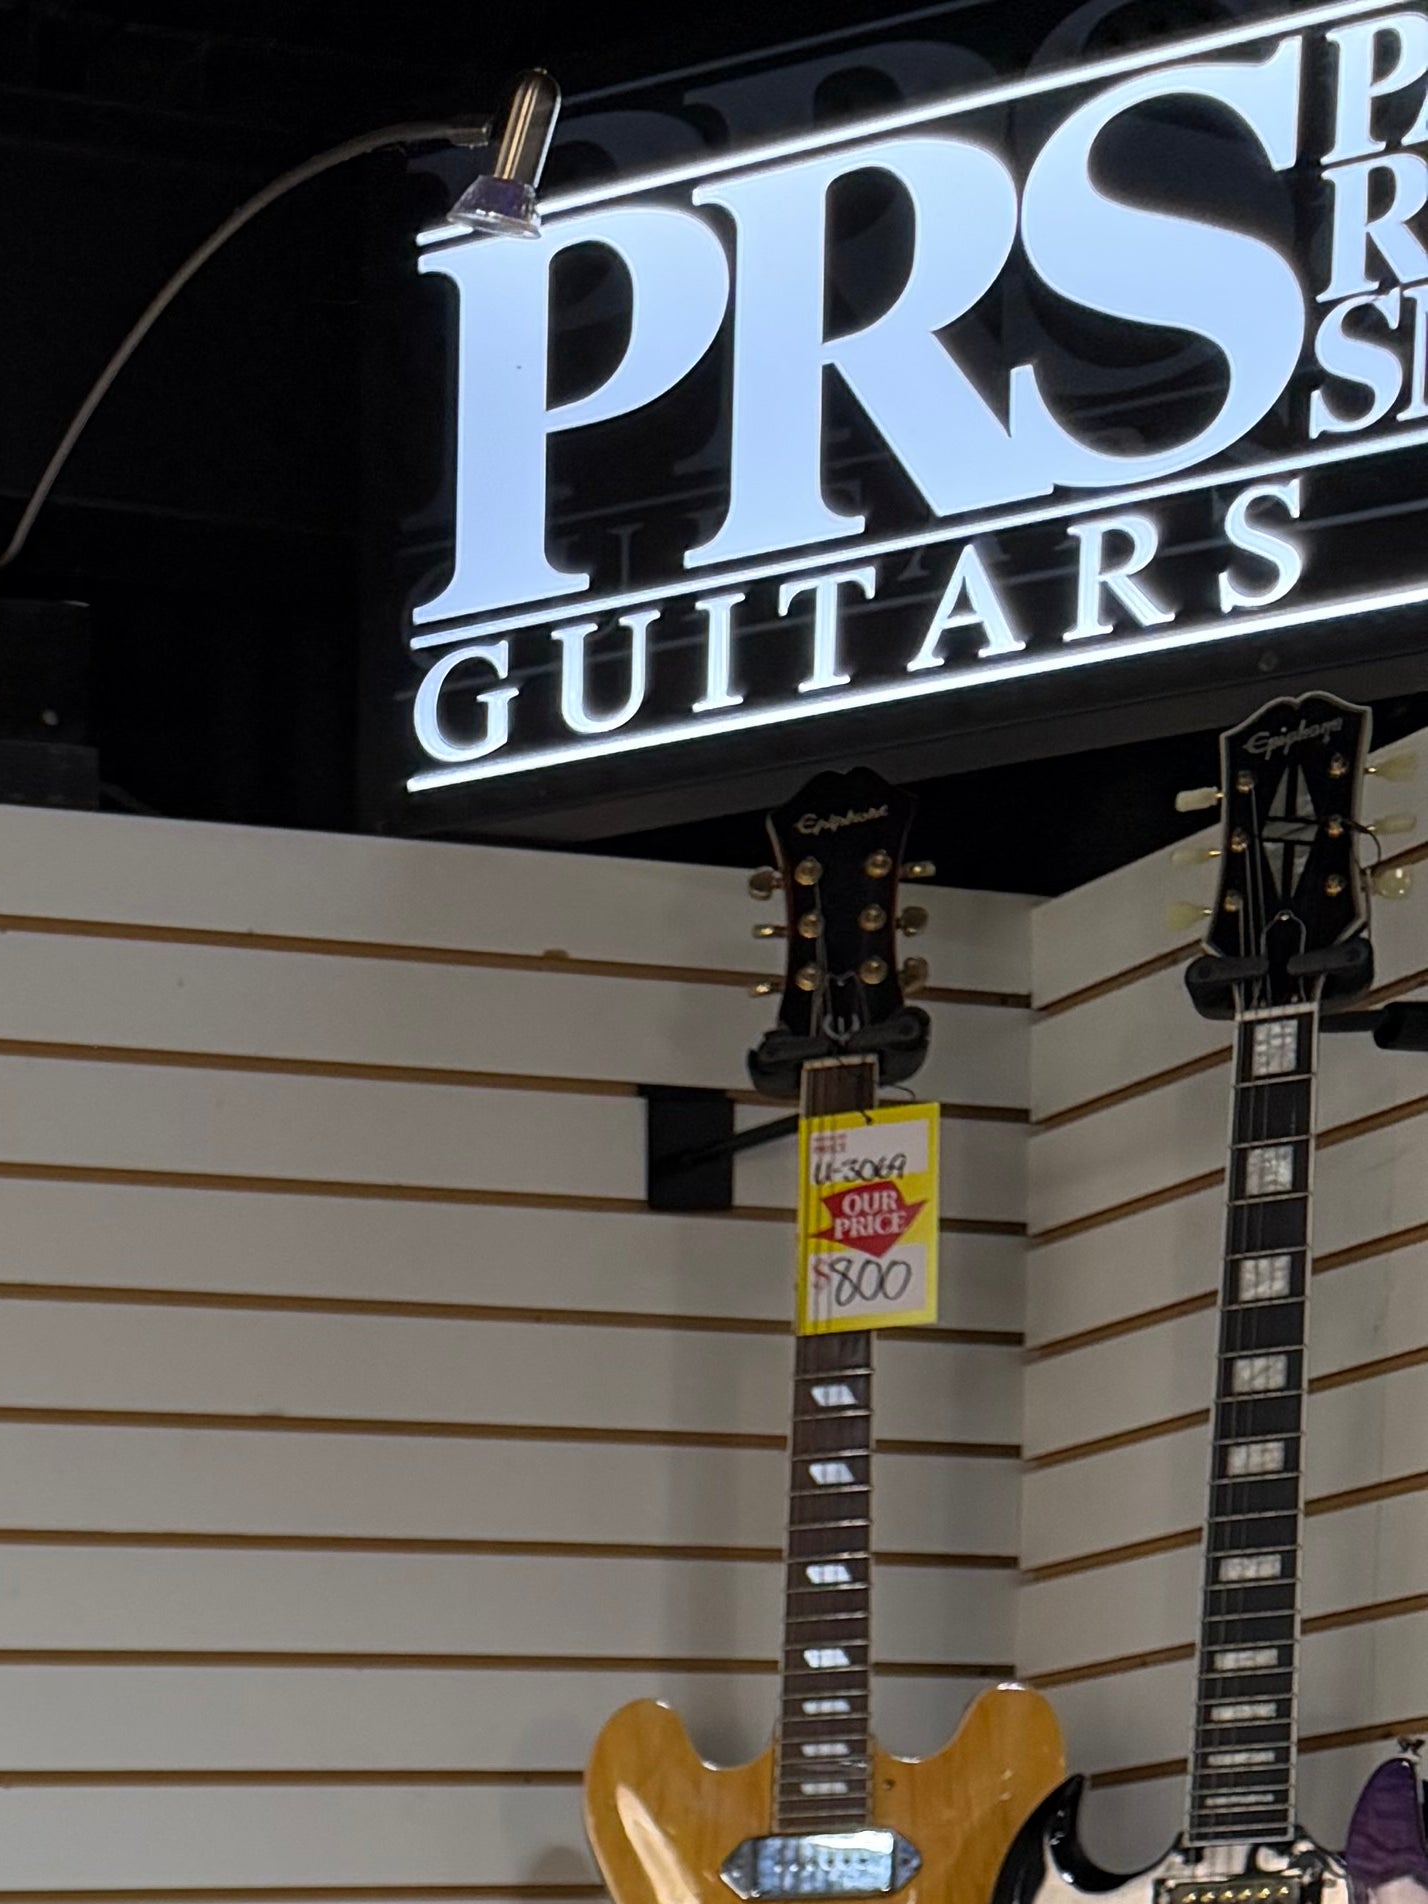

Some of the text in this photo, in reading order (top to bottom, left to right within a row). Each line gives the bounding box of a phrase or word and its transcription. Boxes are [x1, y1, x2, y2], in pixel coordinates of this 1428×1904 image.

[1320, 11, 1428, 165] P
[413, 34, 1306, 625] PRS
[412, 479, 1303, 763] GUITARS
[833, 1212, 907, 1241] PRICE
[842, 1189, 898, 1217] OUR
